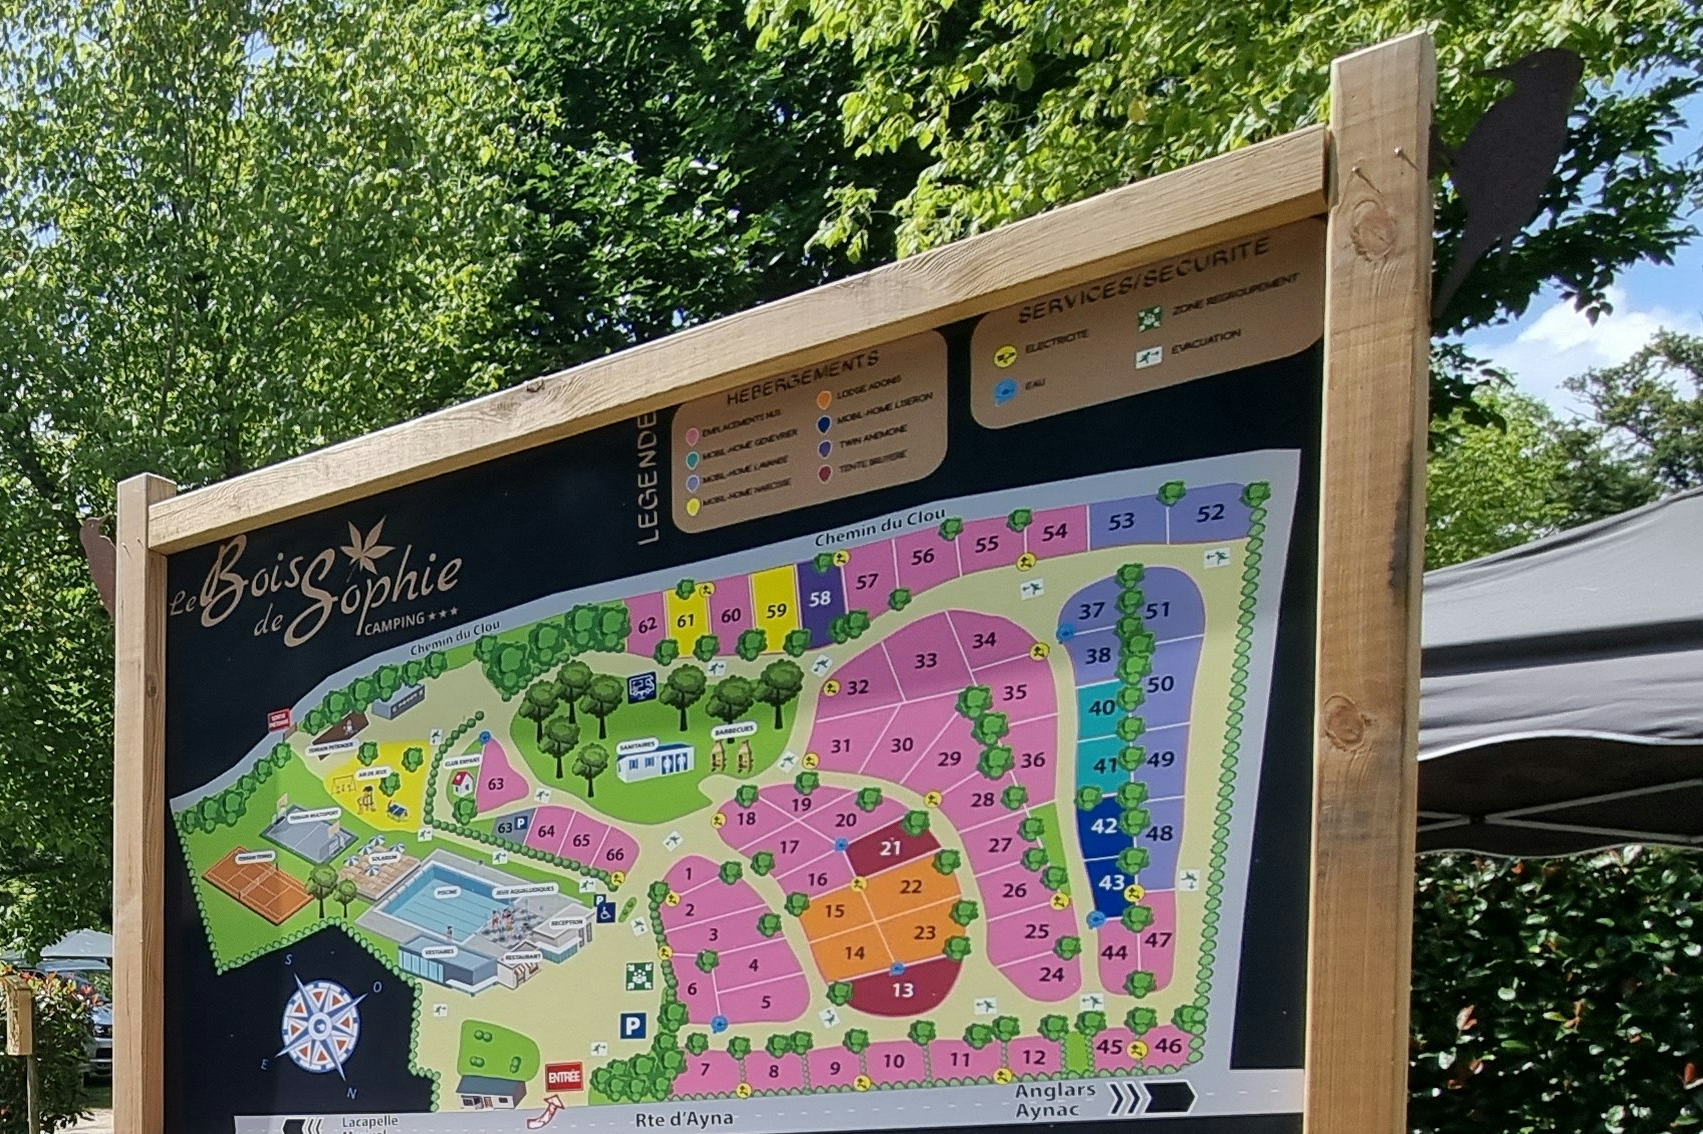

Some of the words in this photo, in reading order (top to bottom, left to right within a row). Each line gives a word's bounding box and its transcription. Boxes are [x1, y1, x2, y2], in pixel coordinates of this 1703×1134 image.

[1171, 328, 1242, 355] EVACUATION
[726, 350, 880, 406] HEBERGEMENTS
[1025, 378, 1046, 391] EAU
[637, 411, 659, 546] LEGENDE
[1197, 504, 1225, 522] 52
[815, 525, 877, 548] Chemin
[881, 517, 903, 532] du
[907, 508, 946, 526] Clou
[1109, 512, 1135, 531] 53
[1042, 523, 1068, 541] 54
[975, 536, 999, 553] 55
[911, 549, 935, 565] 56
[169, 590, 197, 616] Le
[199, 534, 304, 628] Bois
[856, 573, 879, 590] 57
[253, 603, 284, 636] de
[284, 544, 463, 647] Sophie
[809, 591, 831, 607] 58
[721, 608, 741, 623] 60
[766, 603, 787, 619] 59
[1078, 602, 1105, 620] 37
[1145, 601, 1170, 620] 51
[364, 611, 425, 636] CAMPING
[638, 617, 657, 634] 62
[677, 614, 694, 628] 61
[410, 636, 454, 656] Chemin
[456, 629, 471, 641] du
[473, 620, 501, 635] Clou
[972, 632, 996, 649] 34
[914, 653, 937, 669] 33
[1085, 648, 1111, 664] 38
[847, 679, 869, 695] 32
[1146, 675, 1174, 693] 50
[1003, 684, 1027, 701] 35
[1089, 700, 1115, 716] 40
[715, 725, 754, 736] BARBECUES
[619, 741, 655, 750] SANITAIRES
[831, 739, 850, 753] 31
[891, 737, 913, 752] 30
[937, 752, 961, 767] 29
[1021, 752, 1046, 768] 36
[1093, 757, 1117, 773] 41
[1147, 751, 1175, 767] 49
[488, 778, 504, 790] 63
[792, 798, 811, 812] 19
[971, 792, 995, 807] 28
[738, 812, 756, 825] 18
[836, 813, 857, 827] 20
[1091, 818, 1117, 834] 42
[498, 822, 512, 833] 63
[538, 825, 555, 838] 64
[1146, 825, 1173, 841] 48
[573, 834, 590, 847] 65
[780, 841, 799, 854] 17
[880, 841, 901, 855] 21
[988, 838, 1012, 852] 27
[606, 848, 624, 861] 66
[685, 868, 692, 880] 1
[808, 872, 828, 887] 16
[899, 880, 922, 894] 22
[1098, 875, 1125, 890] 43
[1002, 883, 1027, 898] 26
[685, 904, 695, 916] 2
[825, 904, 845, 918] 15
[709, 928, 718, 942] 3
[913, 926, 936, 940] 23
[1024, 924, 1049, 939] 25
[1145, 932, 1172, 947] 47
[284, 954, 293, 965] S
[845, 946, 865, 960] 14
[1101, 945, 1128, 960] 44
[748, 959, 759, 972] 4
[1039, 967, 1064, 982] 24
[373, 982, 383, 993] O
[687, 982, 697, 996] 6
[892, 983, 914, 997] 13
[761, 996, 771, 1009] 5
[626, 1017, 641, 1034] P
[1097, 1039, 1123, 1054] 45
[1155, 1038, 1182, 1053] 46
[260, 1059, 268, 1071] E
[884, 1054, 905, 1068] 10
[950, 1053, 970, 1066] 11
[1023, 1050, 1046, 1065] 12
[548, 1069, 580, 1083] ENTRÉE
[700, 1063, 710, 1076] 7
[769, 1065, 779, 1078] 8
[829, 1062, 841, 1075] 9
[347, 1088, 357, 1099] N
[1015, 1082, 1096, 1101] Anglars
[1015, 1103, 1080, 1120] Aynac
[342, 1115, 399, 1129] Lacapelle
[636, 1113, 665, 1127] Rte
[670, 1111, 734, 1129] d'Ayna
